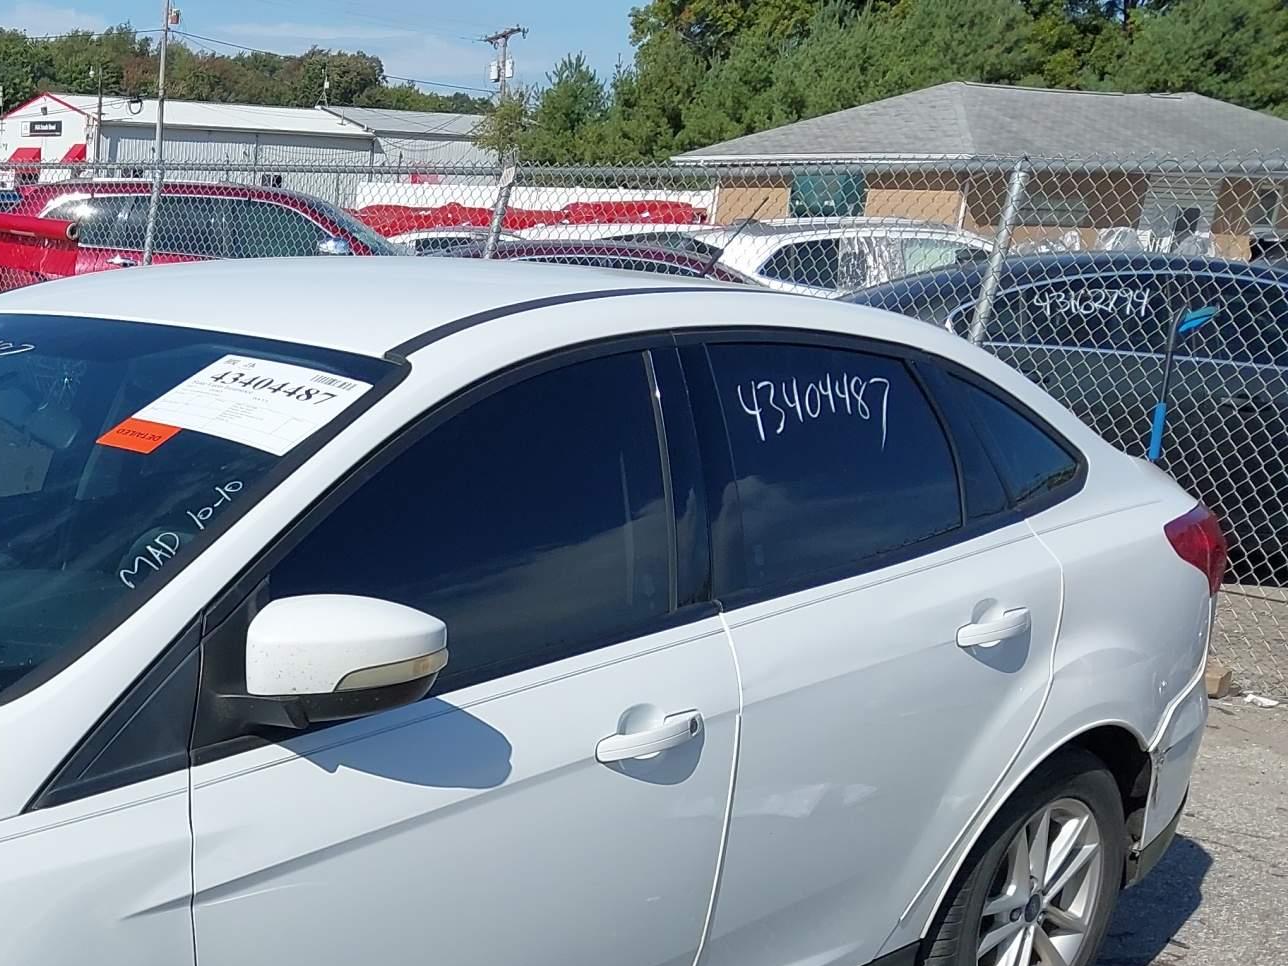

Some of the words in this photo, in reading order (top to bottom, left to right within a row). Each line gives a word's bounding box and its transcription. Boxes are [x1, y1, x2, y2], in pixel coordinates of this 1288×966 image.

[1033, 287, 1151, 317] 43162794
[209, 369, 338, 405] 43404487
[736, 371, 891, 452] 43404487
[115, 427, 163, 442] DETAILED
[118, 531, 181, 590] MAD
[186, 479, 244, 531] 10-10
